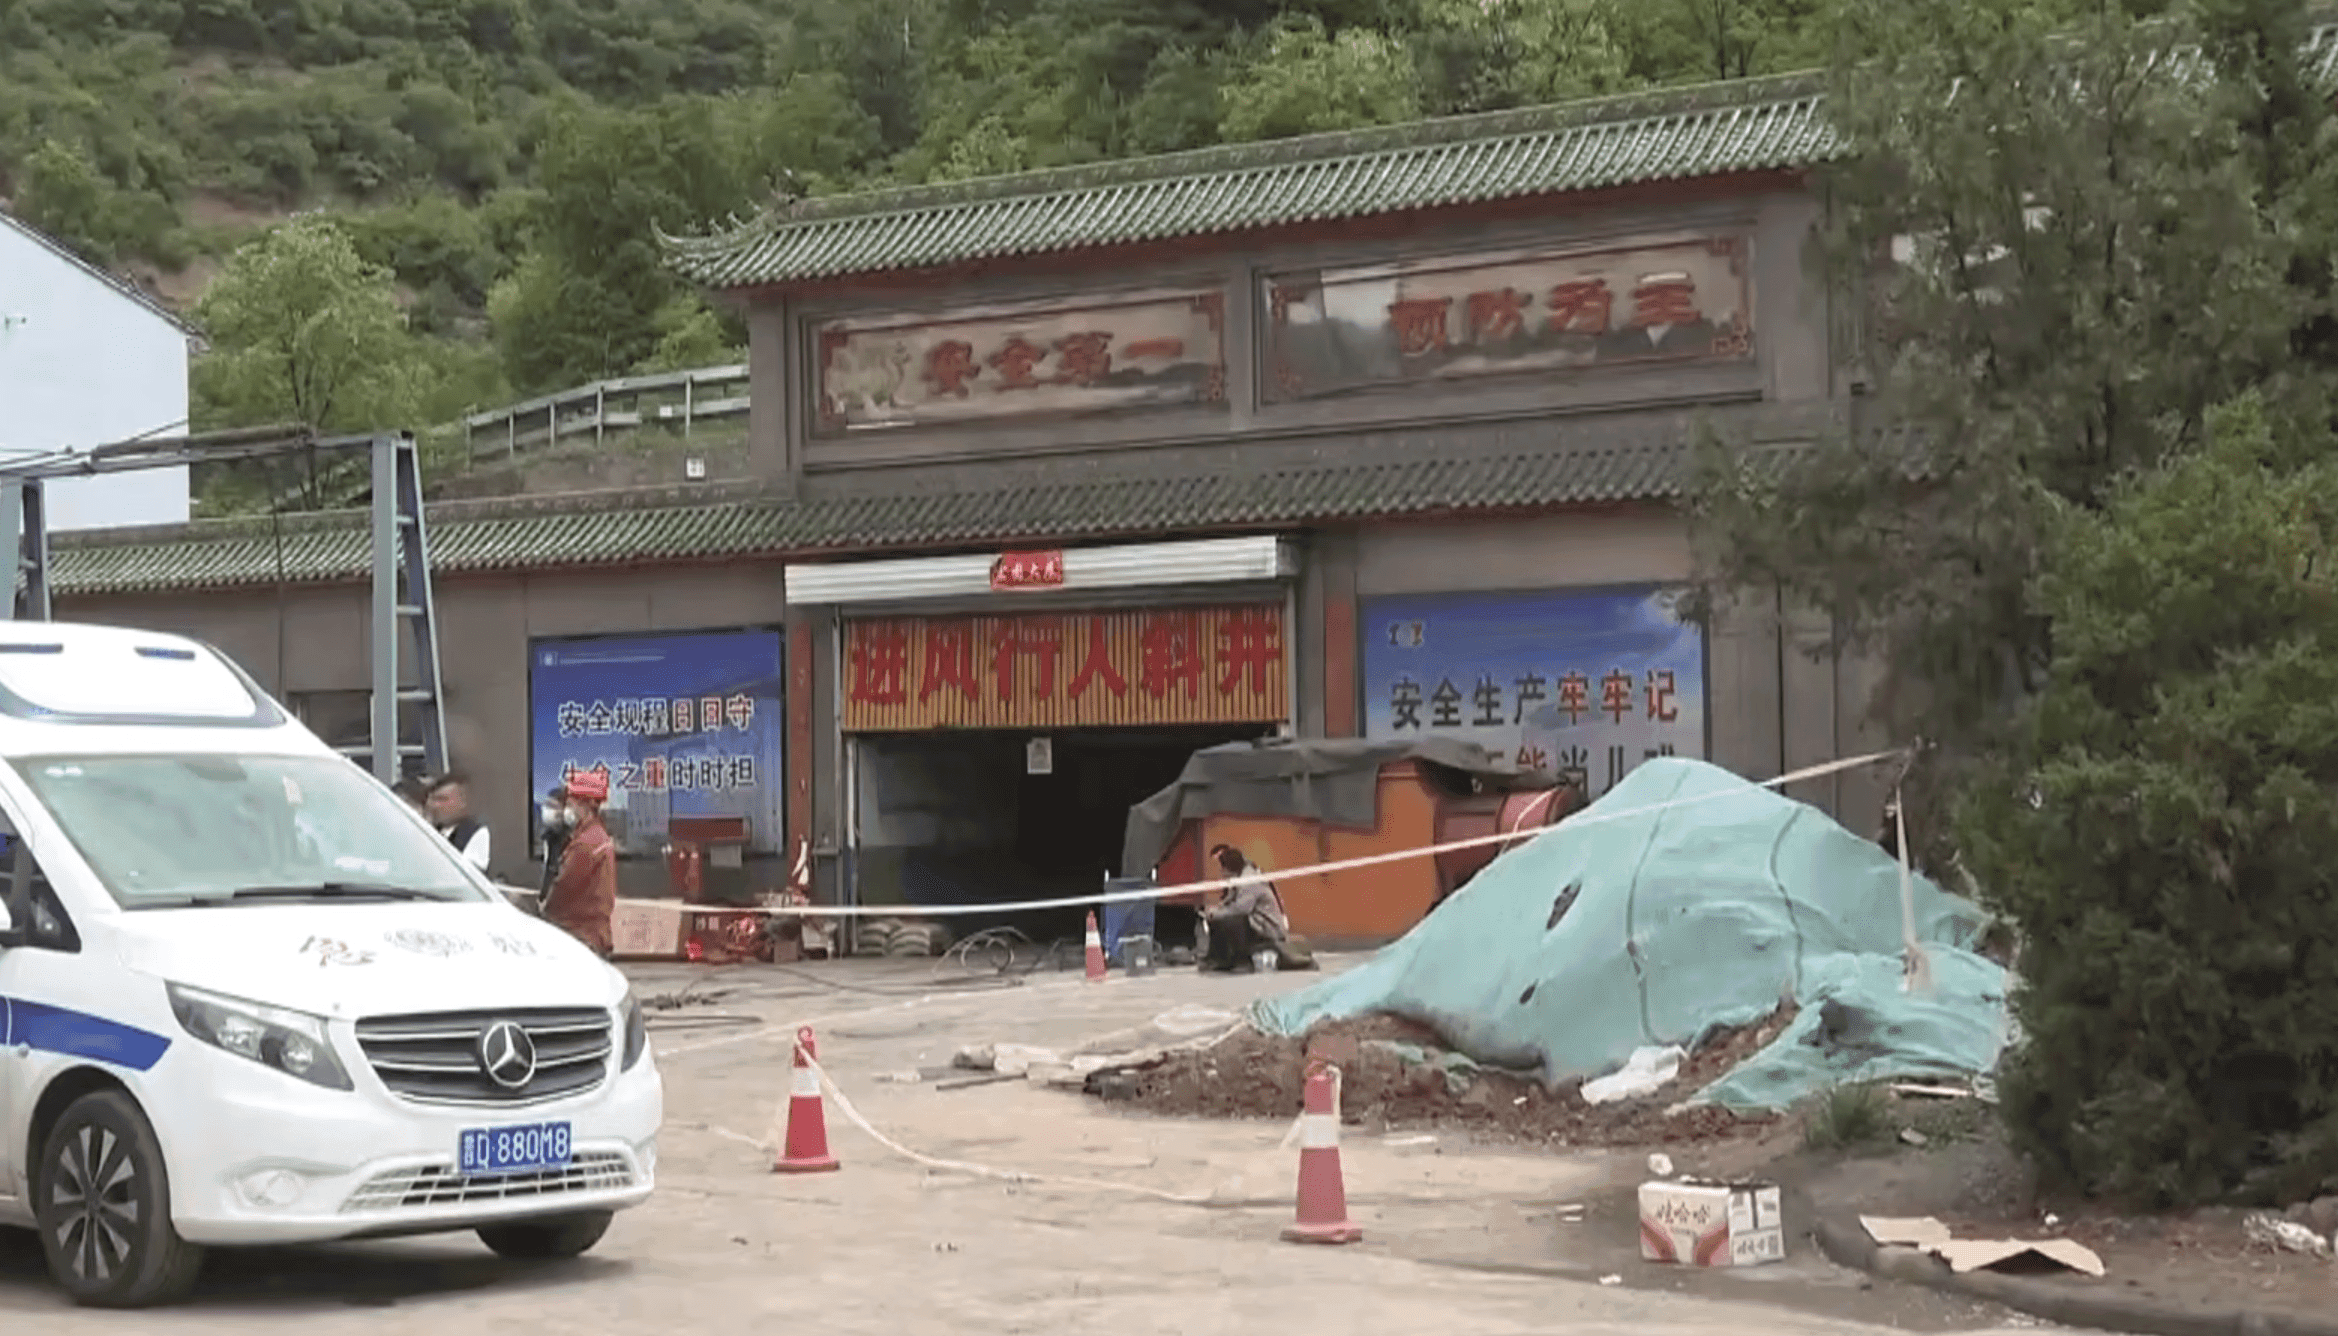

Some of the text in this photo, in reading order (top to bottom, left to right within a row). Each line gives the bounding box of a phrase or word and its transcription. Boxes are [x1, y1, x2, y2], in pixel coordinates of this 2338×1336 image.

[1390, 670, 1678, 730] 安全生产牢牢记
